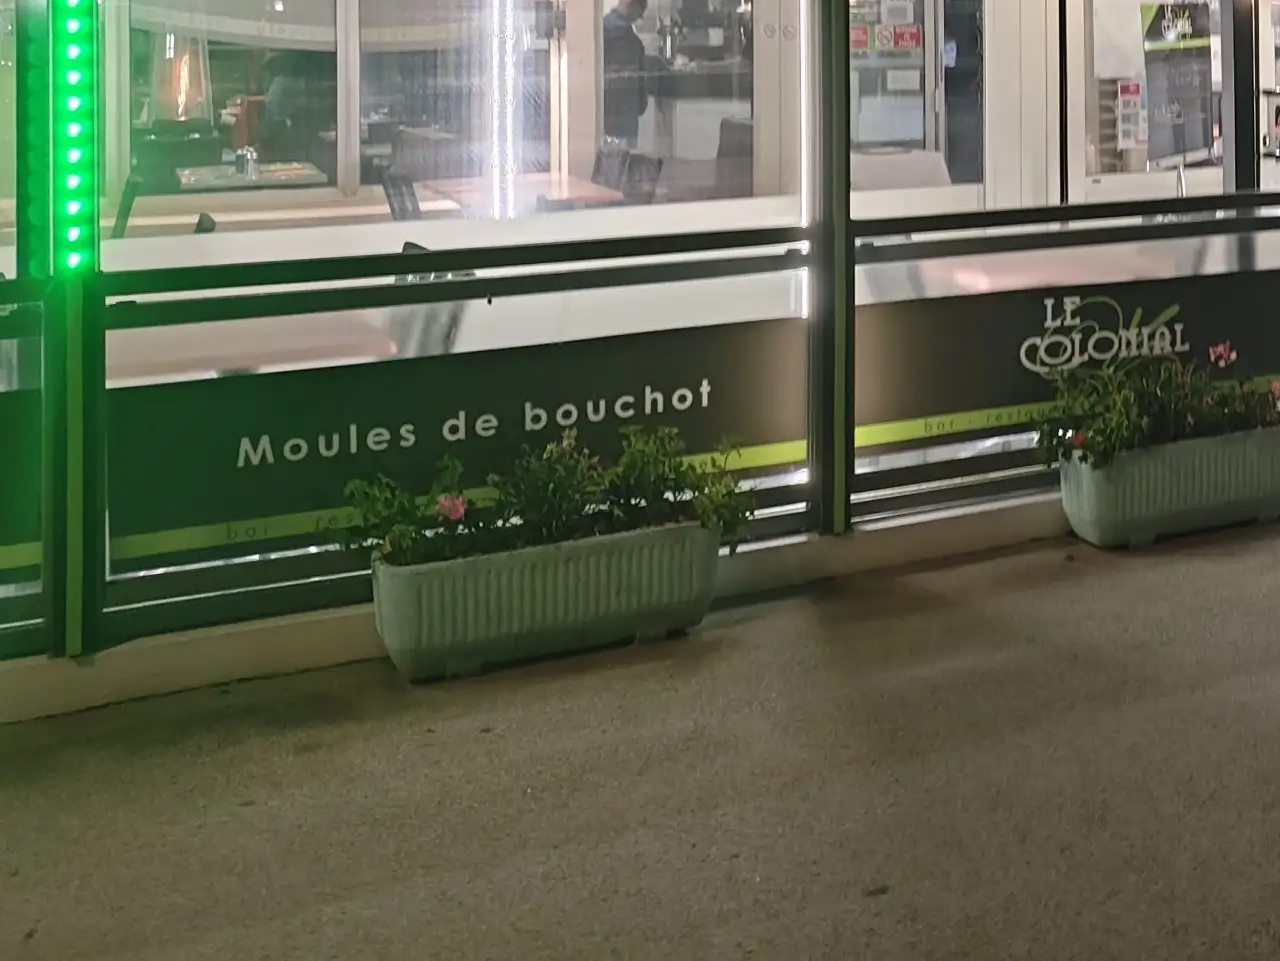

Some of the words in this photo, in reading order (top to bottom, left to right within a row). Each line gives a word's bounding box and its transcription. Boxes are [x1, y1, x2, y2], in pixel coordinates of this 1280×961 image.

[1044, 296, 1081, 328] LE
[1020, 322, 1190, 374] COLONIAL
[237, 418, 416, 468] Moules
[442, 410, 498, 441] de
[525, 379, 712, 432] bouchot
